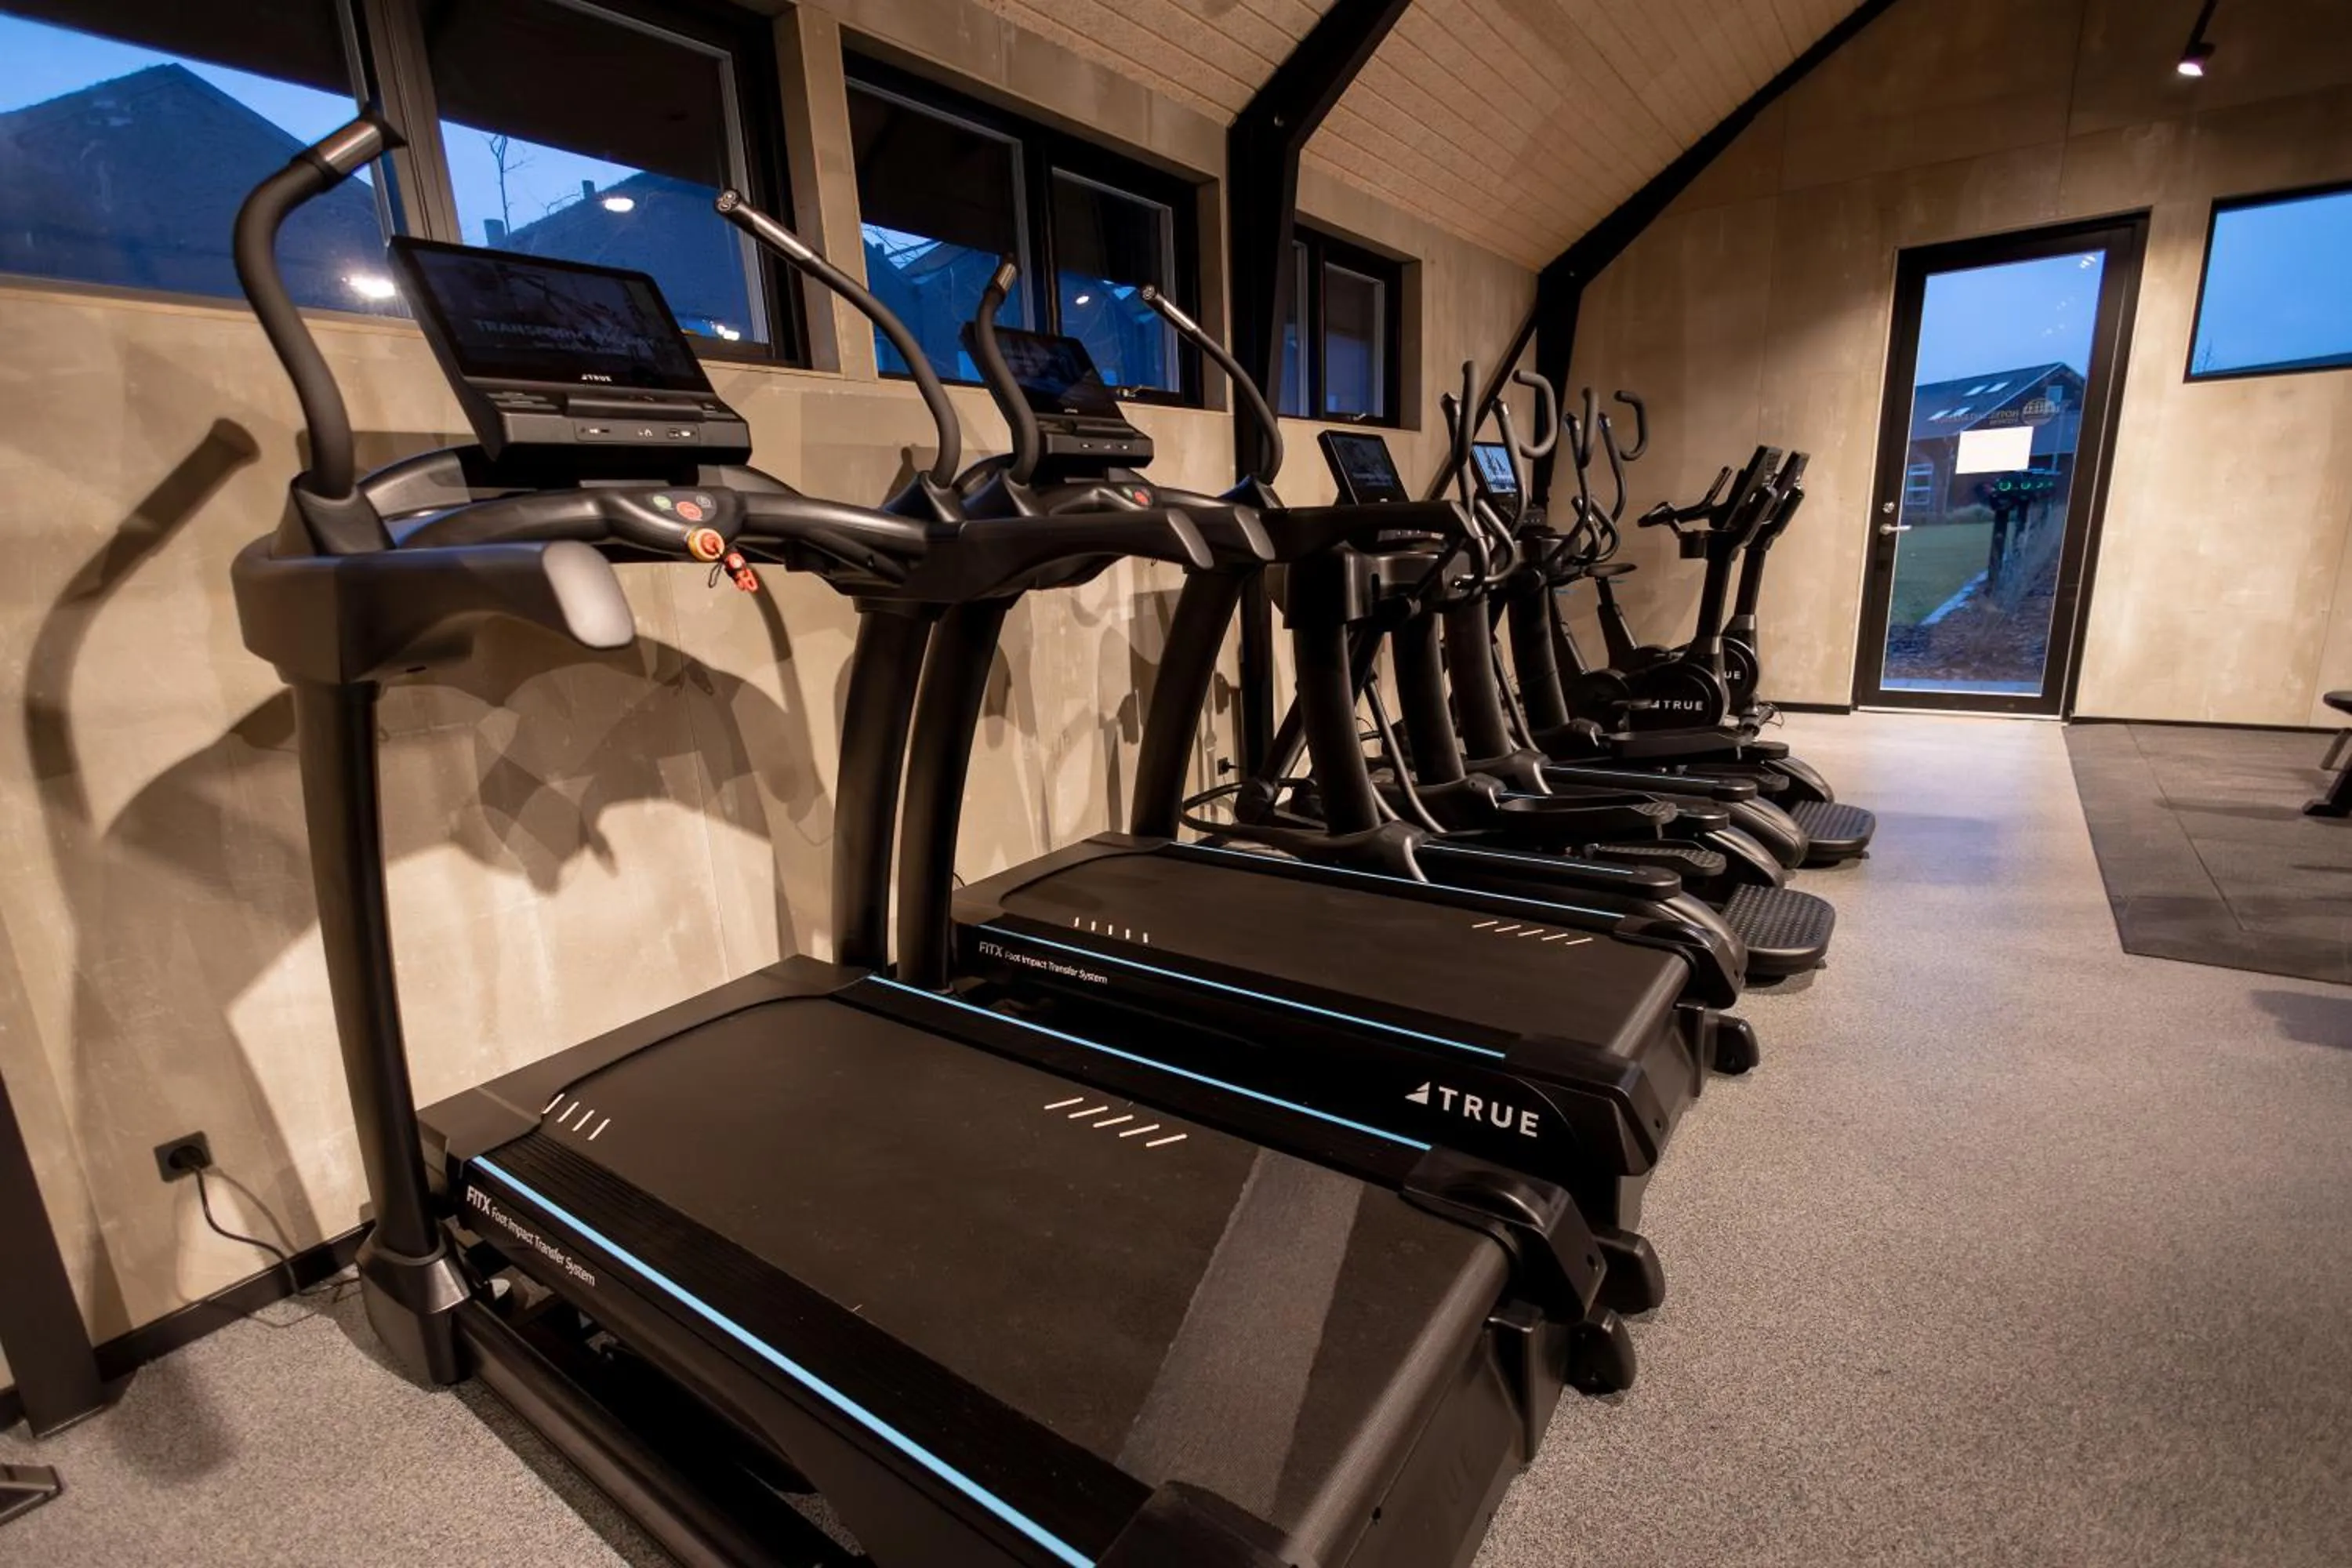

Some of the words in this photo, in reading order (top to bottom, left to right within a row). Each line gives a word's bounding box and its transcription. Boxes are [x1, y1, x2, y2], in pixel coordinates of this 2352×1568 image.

[1662, 699, 1704, 711] TRUE
[978, 941, 1004, 958] FITX
[1004, 949, 1021, 963] Foot
[1022, 953, 1047, 971] Impact
[1048, 960, 1078, 978] Transfer
[1078, 968, 1108, 985] System
[1438, 1085, 1540, 1138] TRUE
[466, 1185, 492, 1215] FITX
[492, 1207, 508, 1228] Foot
[507, 1218, 534, 1246] Impact
[534, 1235, 564, 1265] Transfer
[564, 1256, 596, 1287] System
